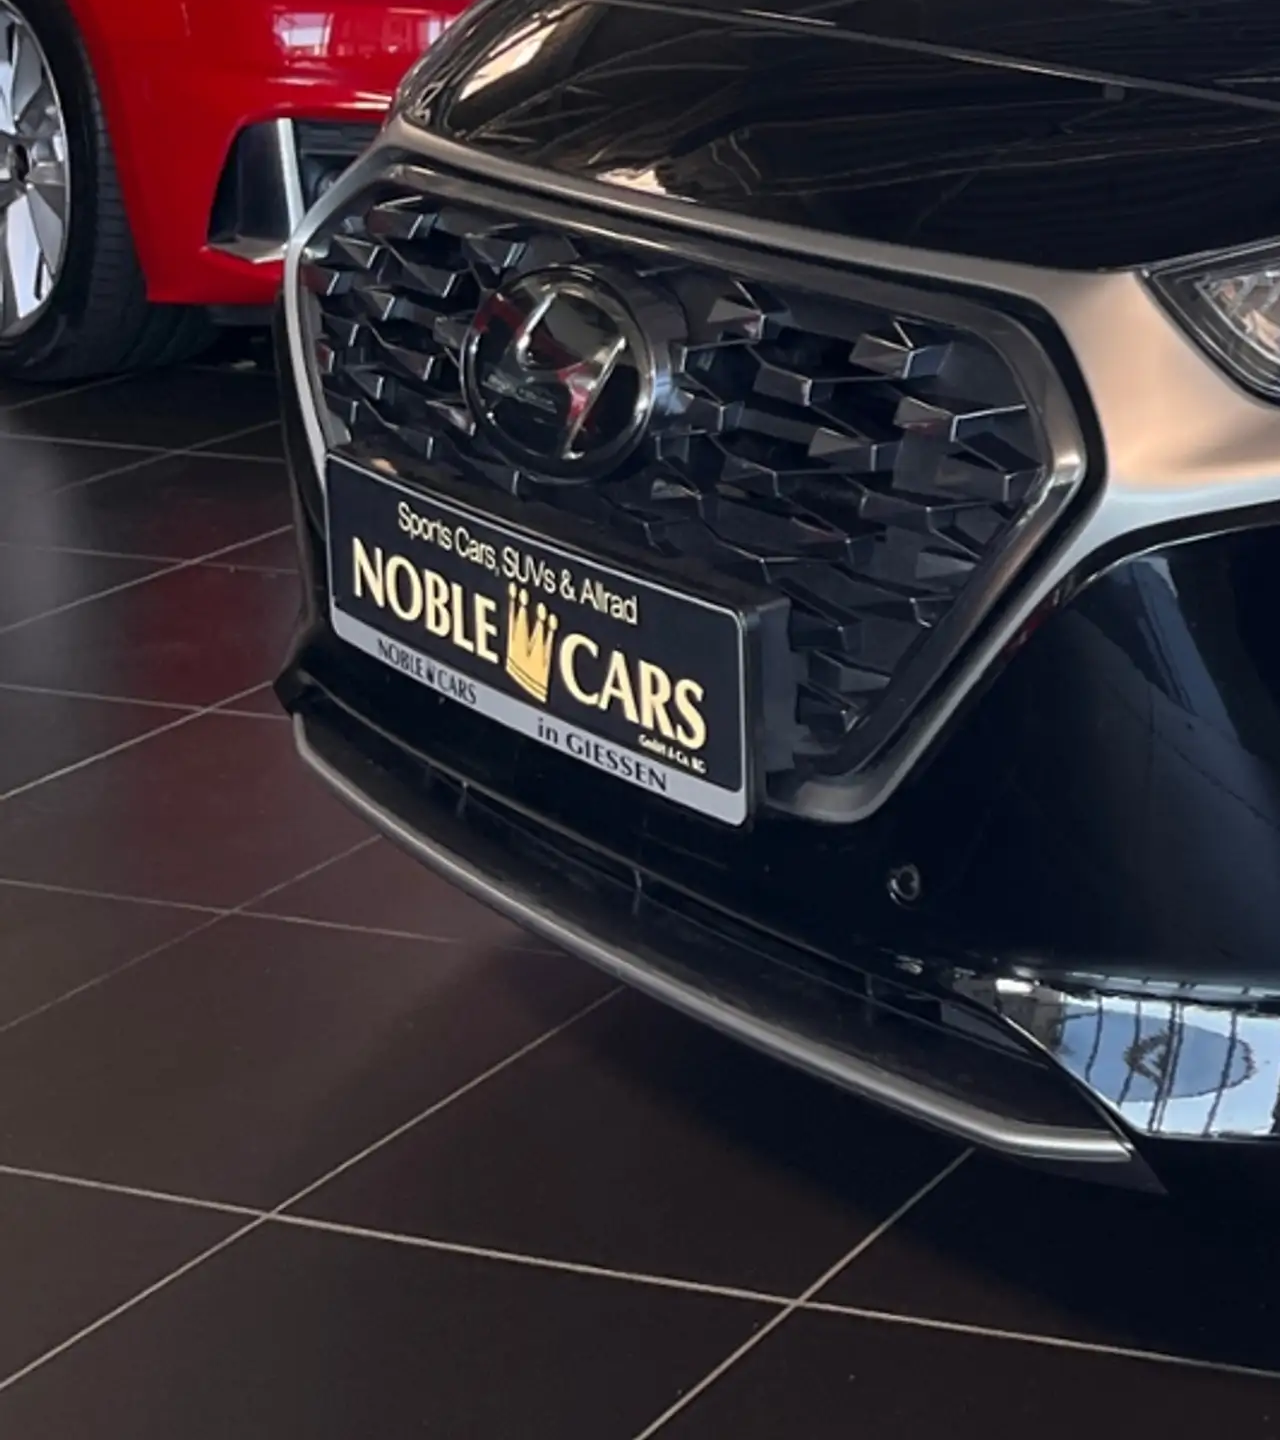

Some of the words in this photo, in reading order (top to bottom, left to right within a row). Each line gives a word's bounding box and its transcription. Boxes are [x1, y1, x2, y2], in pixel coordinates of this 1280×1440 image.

[397, 500, 453, 551] Sports
[454, 525, 501, 577] Cars,
[501, 545, 557, 594] SUVs
[559, 568, 578, 602] &
[579, 577, 638, 627] Allrad
[351, 535, 500, 665] NOBLE
[558, 632, 708, 751] CARS
[376, 636, 425, 682] NOBLE
[435, 667, 478, 707] CARS
[536, 716, 559, 745] in
[565, 732, 669, 794] GIESSEN
